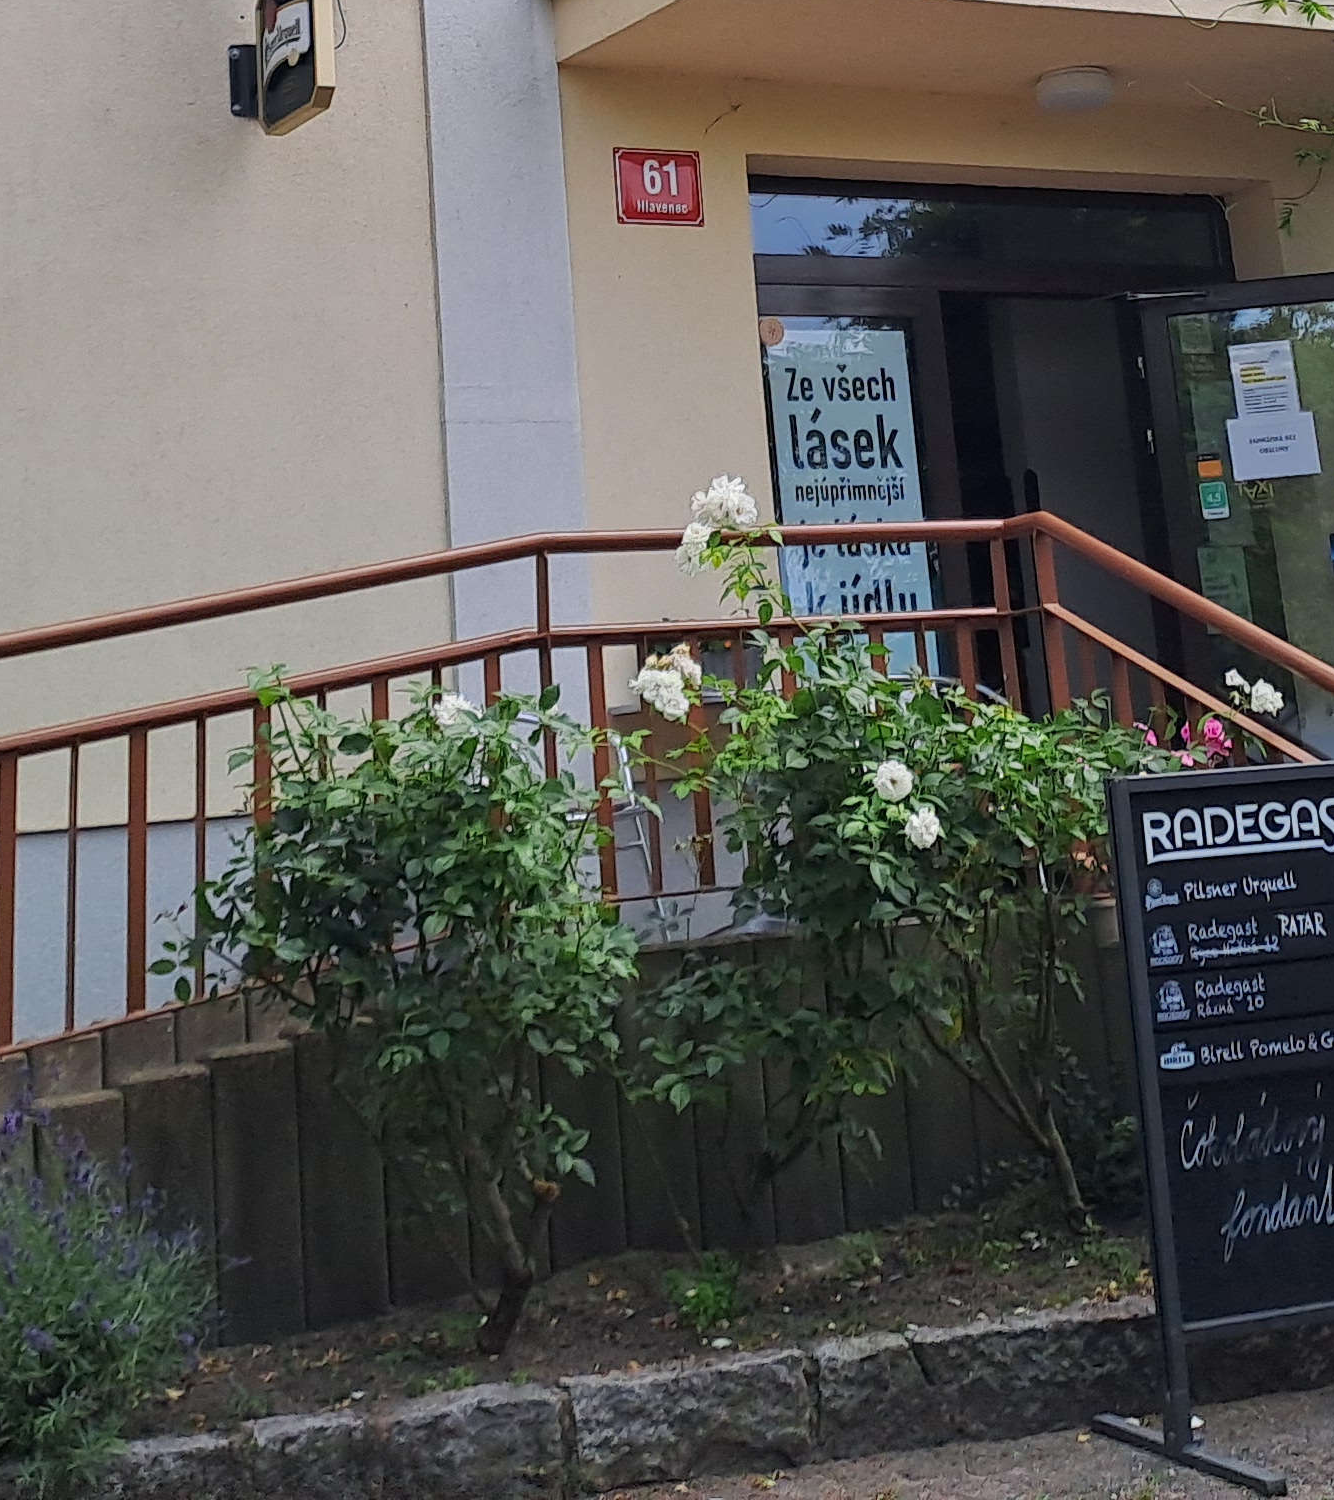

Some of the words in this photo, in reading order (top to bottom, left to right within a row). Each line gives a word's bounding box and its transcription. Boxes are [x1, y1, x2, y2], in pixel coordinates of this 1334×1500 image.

[643, 159, 678, 196] 61
[637, 199, 688, 215] Hlavenec
[784, 367, 813, 402] Ze
[822, 364, 896, 402] všech
[788, 407, 904, 470] lásek
[1183, 880, 1238, 902] Pilsner
[1243, 870, 1298, 902] Urquell
[1187, 915, 1259, 943] Radegast
[1194, 972, 1267, 1001] Radegast
[1200, 1040, 1245, 1066] Birell
